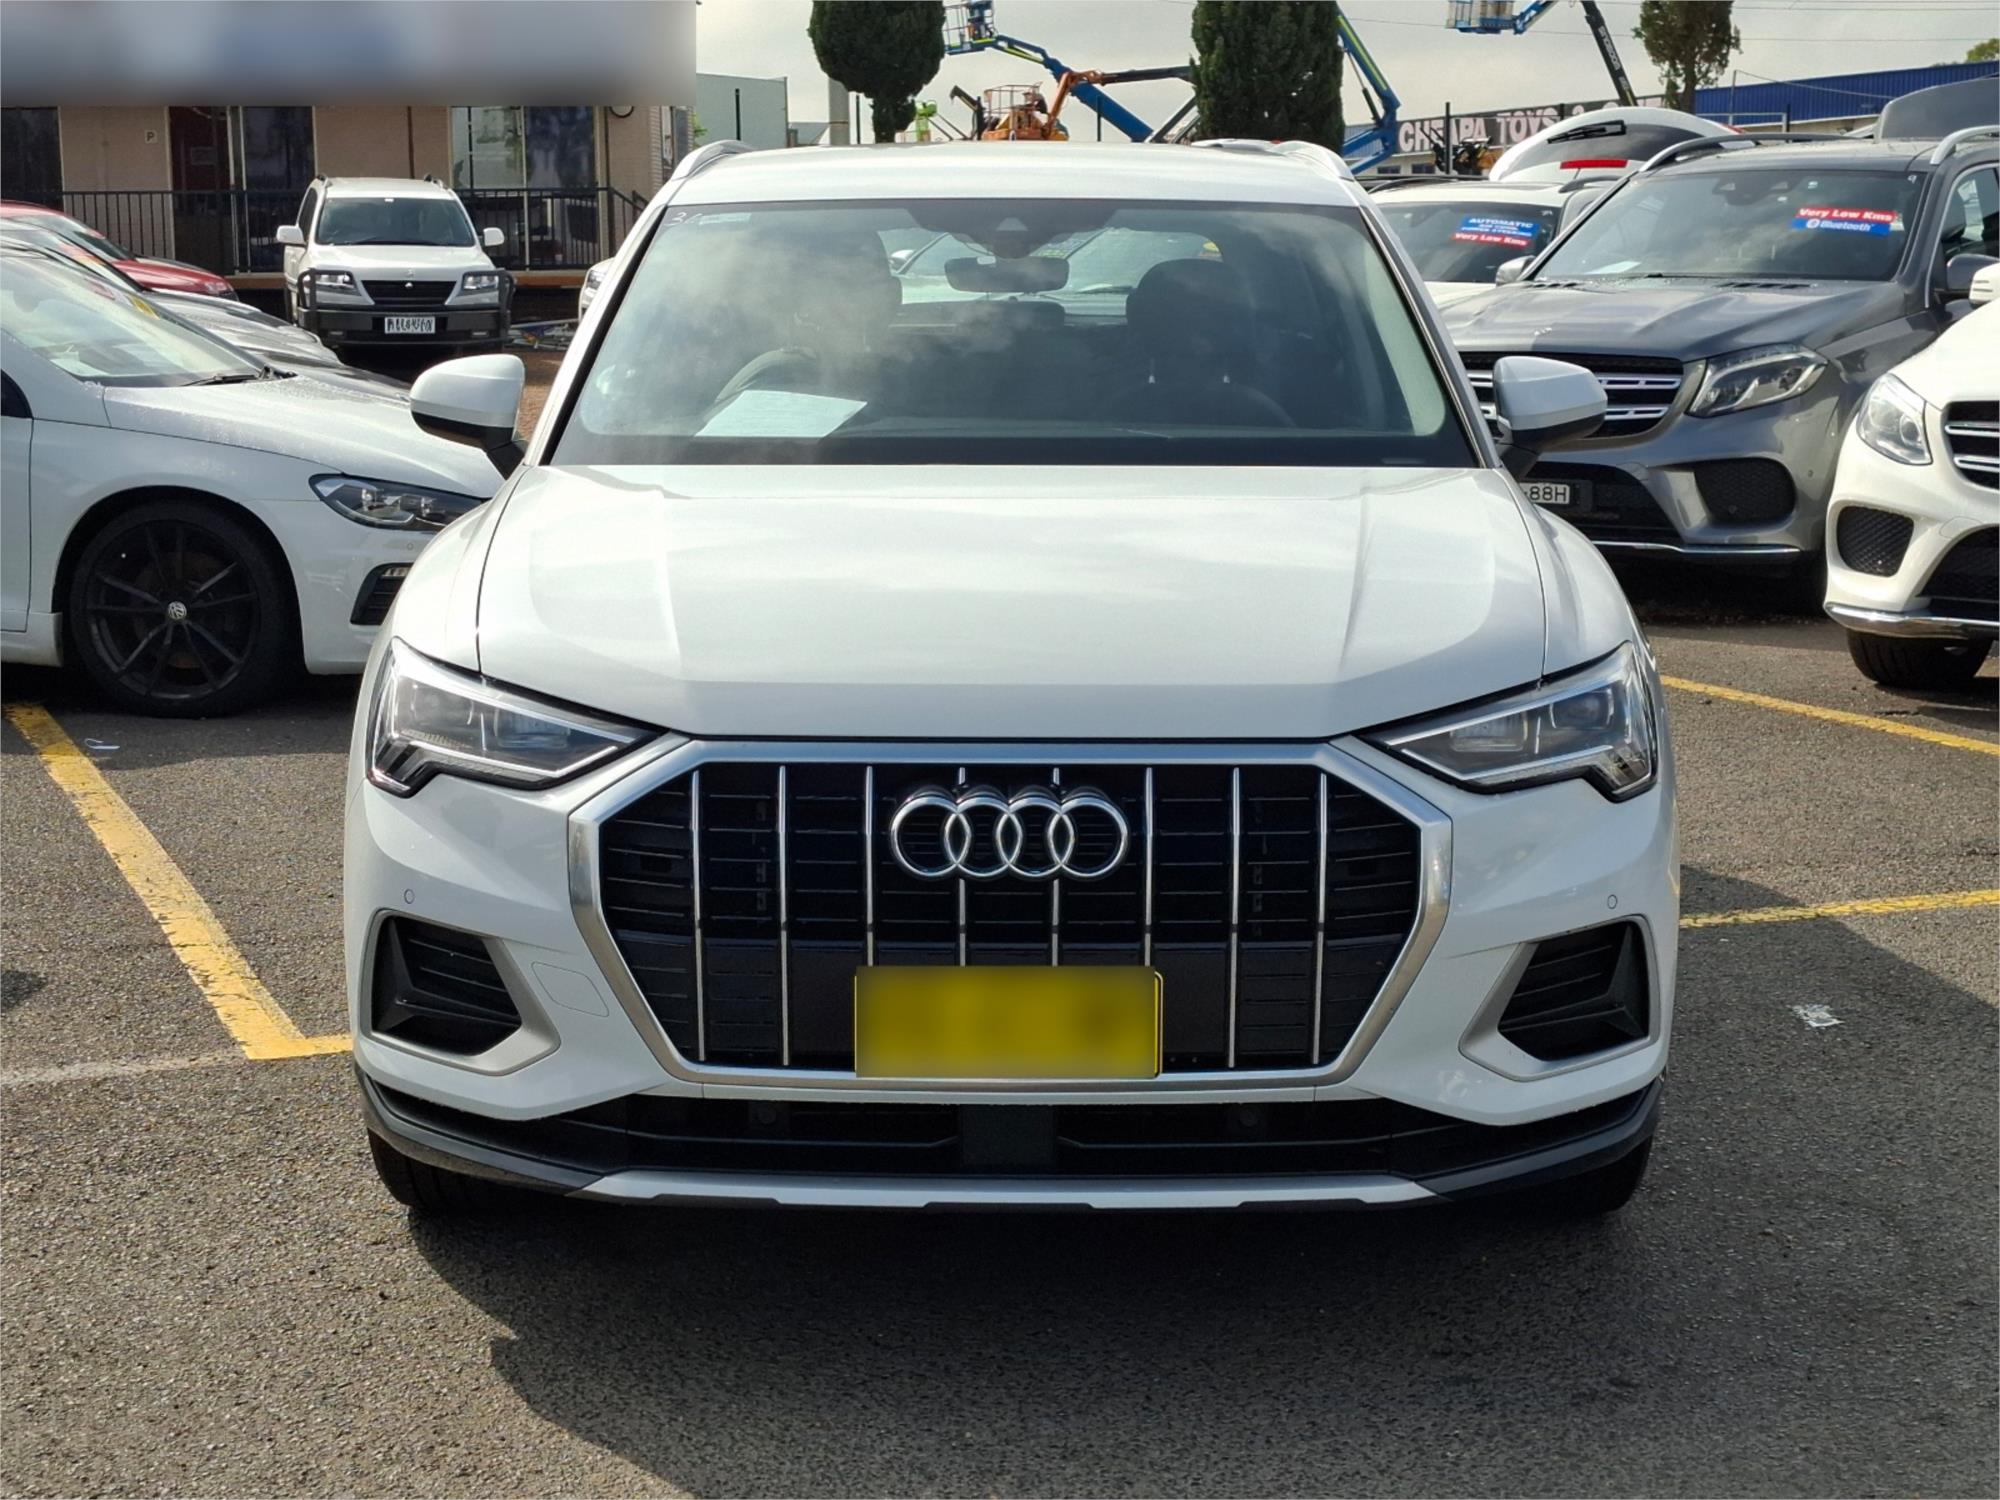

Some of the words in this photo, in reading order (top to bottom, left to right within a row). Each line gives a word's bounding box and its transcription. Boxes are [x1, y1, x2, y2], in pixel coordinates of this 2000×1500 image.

[1798, 208, 1829, 218] Very
[1831, 209, 1860, 218] Low
[1468, 218, 1534, 229] AUTOMATIC
